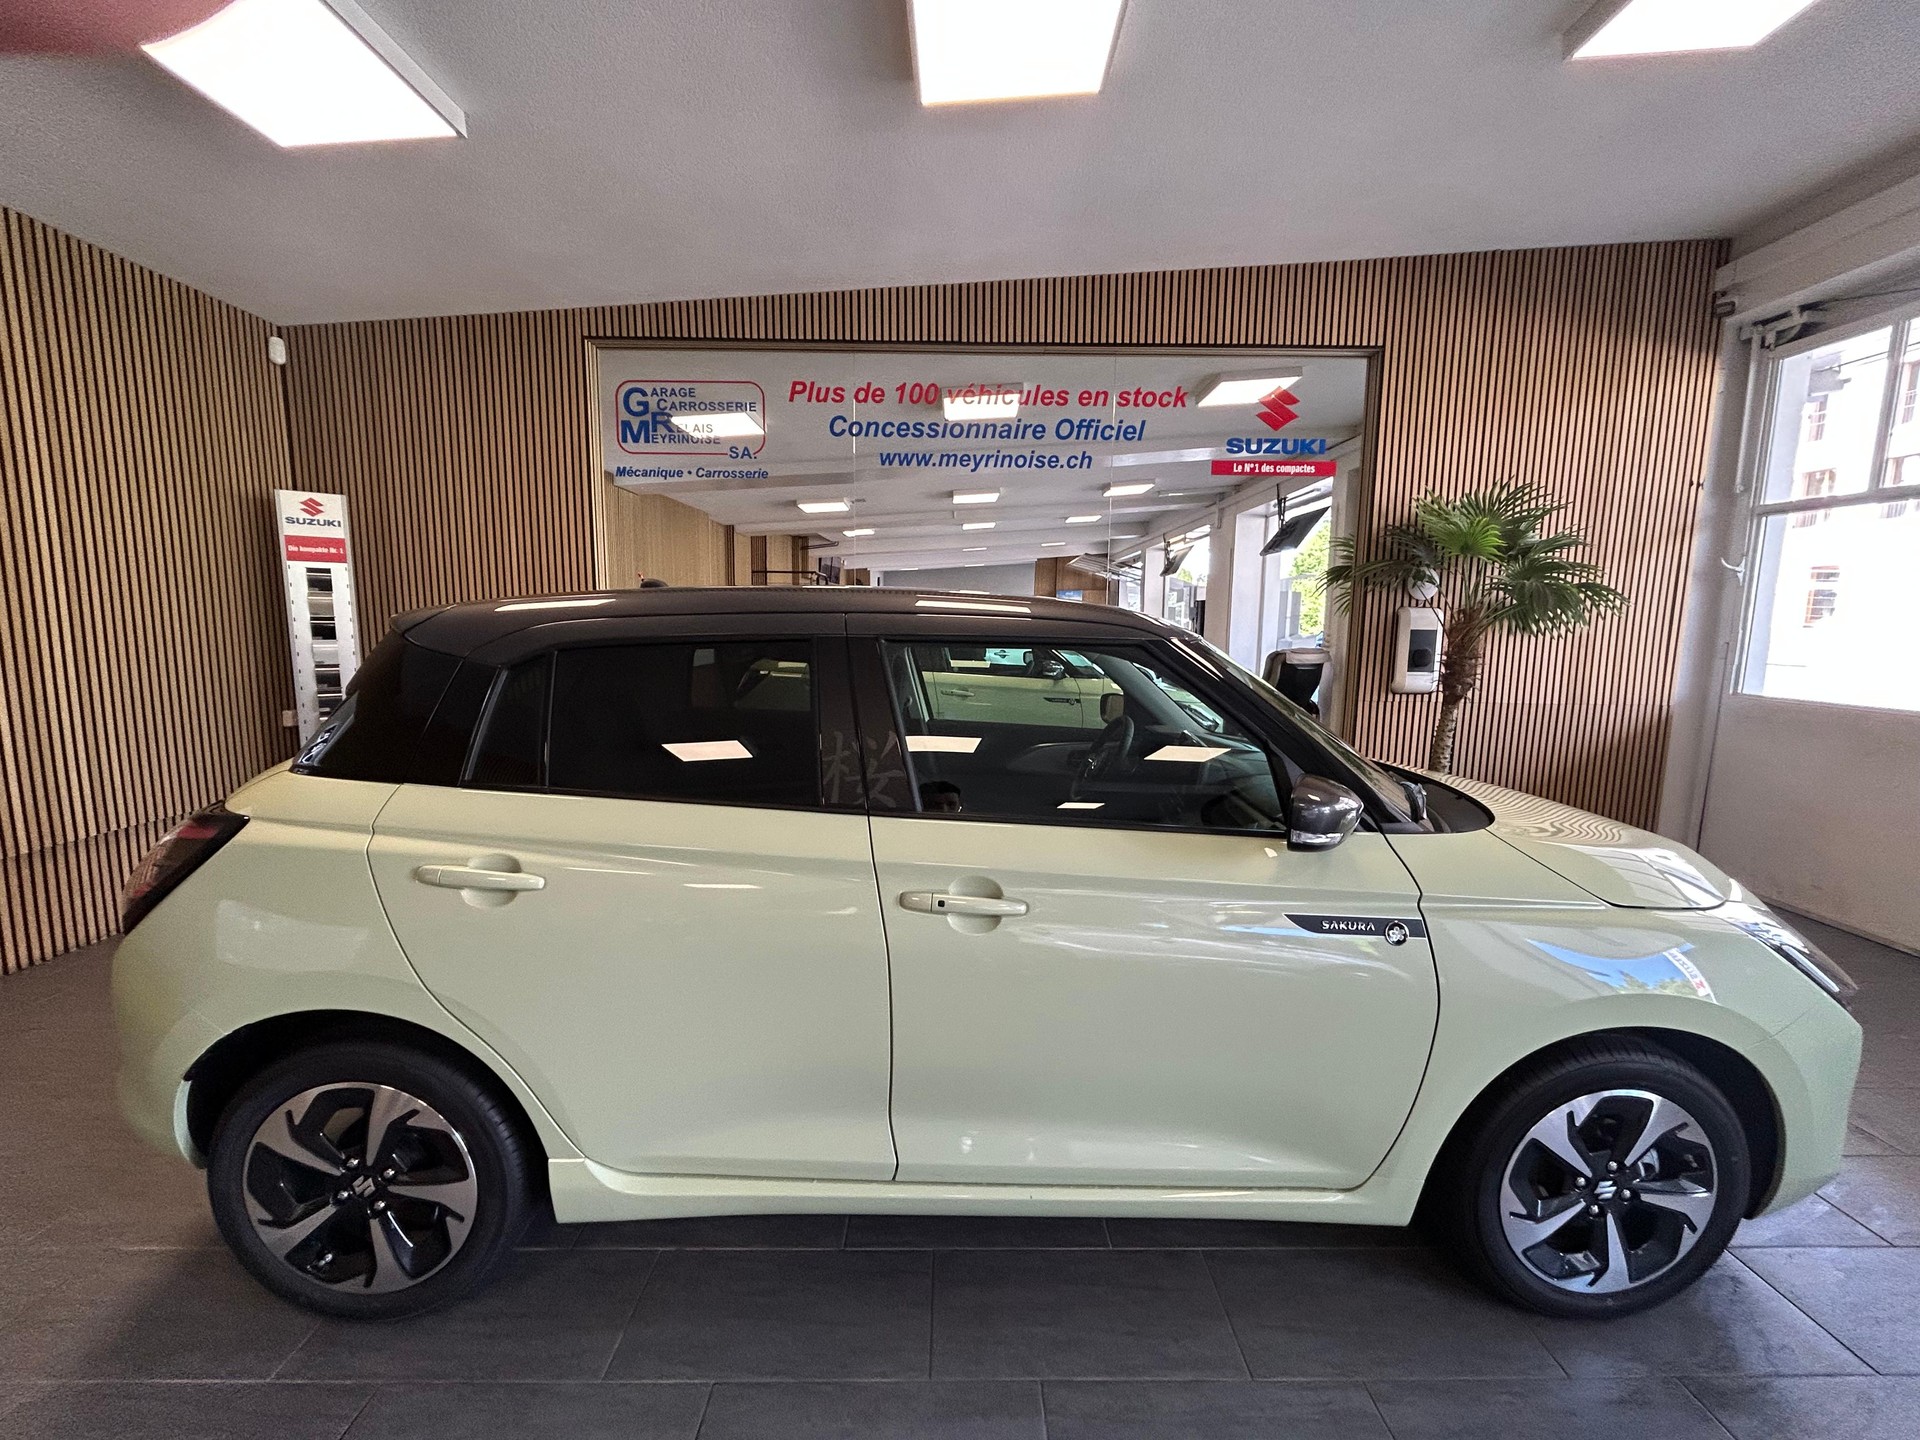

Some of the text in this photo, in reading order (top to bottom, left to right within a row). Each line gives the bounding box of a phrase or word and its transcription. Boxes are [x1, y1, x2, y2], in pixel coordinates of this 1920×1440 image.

[623, 387, 696, 417] GARAGE
[788, 380, 1189, 408] Plus de 100 véhicules en stock
[656, 399, 757, 412] CARROSSERIE
[621, 420, 721, 444] MEYRINOISE
[829, 415, 1147, 441] Concessionnaire Officiel
[1226, 437, 1327, 455] SUZUKI
[879, 450, 1093, 472] www.meyrinoise.ch
[1233, 463, 1243, 473] Le
[1261, 463, 1275, 473] des
[1276, 463, 1315, 475] compactes
[615, 466, 769, 480] Mécanique Carrosserie
[285, 516, 342, 527] SUZUKI
[1321, 920, 1376, 931] SAKURA
